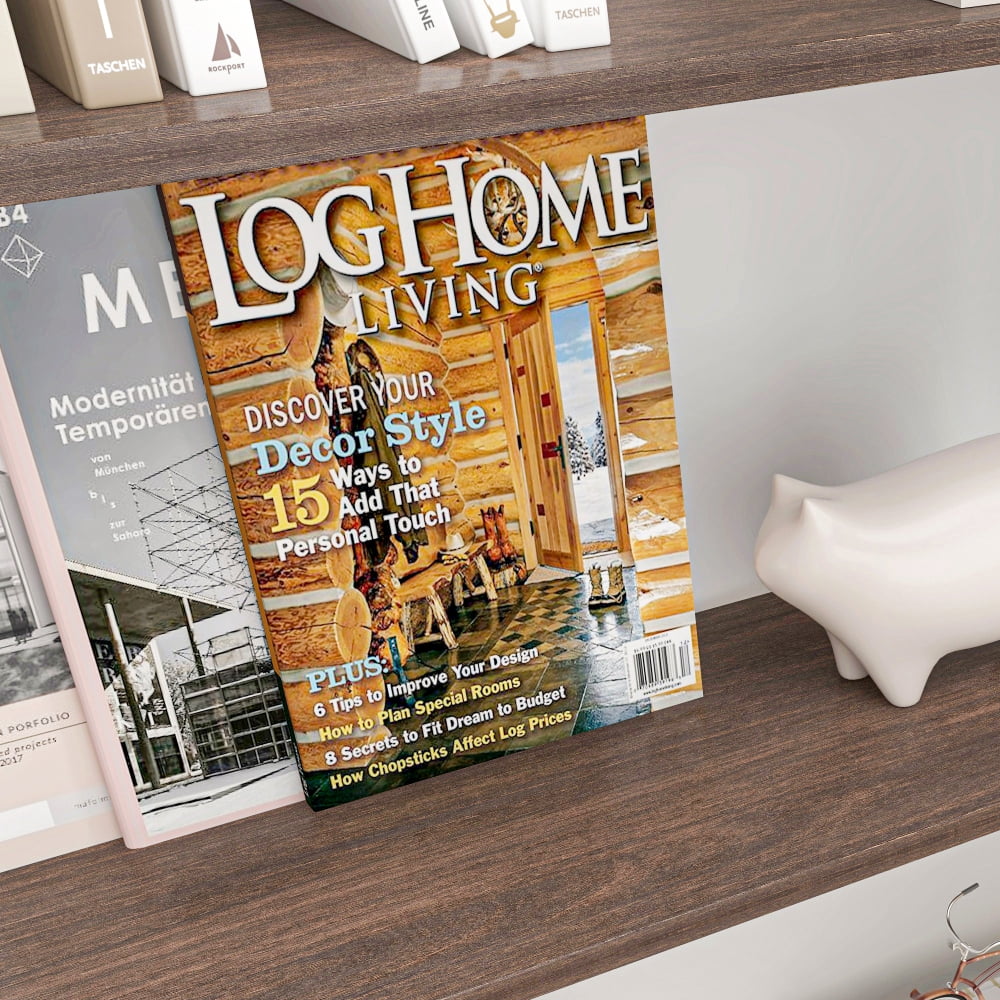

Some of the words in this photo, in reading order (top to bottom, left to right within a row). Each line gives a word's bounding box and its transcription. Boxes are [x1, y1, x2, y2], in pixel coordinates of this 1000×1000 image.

[554, 6, 602, 21] TASCHEN
[87, 58, 147, 76] TASCHEN
[50, 372, 195, 418] Modernität
[244, 385, 368, 433] DISCOVER
[373, 370, 436, 404] YOUR
[90, 453, 111, 464] von
[252, 427, 375, 475] Decor
[384, 400, 488, 450] Style
[94, 459, 145, 477] München
[329, 459, 392, 491] Ways
[397, 454, 422, 477] to
[262, 473, 330, 534] 15
[338, 488, 382, 520] Add
[388, 479, 441, 507] That
[109, 520, 126, 530] zur
[276, 520, 379, 562] Personal
[383, 502, 452, 537] Touch
[305, 655, 390, 694] PLUS:
[313, 702, 327, 718] 6
[330, 692, 363, 718] Tips
[366, 688, 383, 703] to
[386, 668, 449, 700] Improve
[452, 660, 486, 681] Your
[489, 645, 540, 673] Design
[8, 712, 70, 733] PORFOLIO
[318, 721, 354, 743] How
[357, 716, 374, 731] to
[377, 703, 411, 726] Plan
[414, 687, 468, 721] Special
[471, 674, 521, 700] Rooms
[324, 750, 337, 766] 8
[340, 733, 399, 763] Secrets
[402, 728, 419, 743] to
[421, 719, 443, 739] Fit
[446, 707, 494, 732] Dream
[497, 702, 512, 716] to
[515, 685, 567, 713] Budget
[329, 771, 365, 790] How
[367, 745, 449, 781] Chopsticks
[452, 730, 496, 755] Affect
[499, 722, 526, 743] Log
[528, 709, 574, 731] Prices
